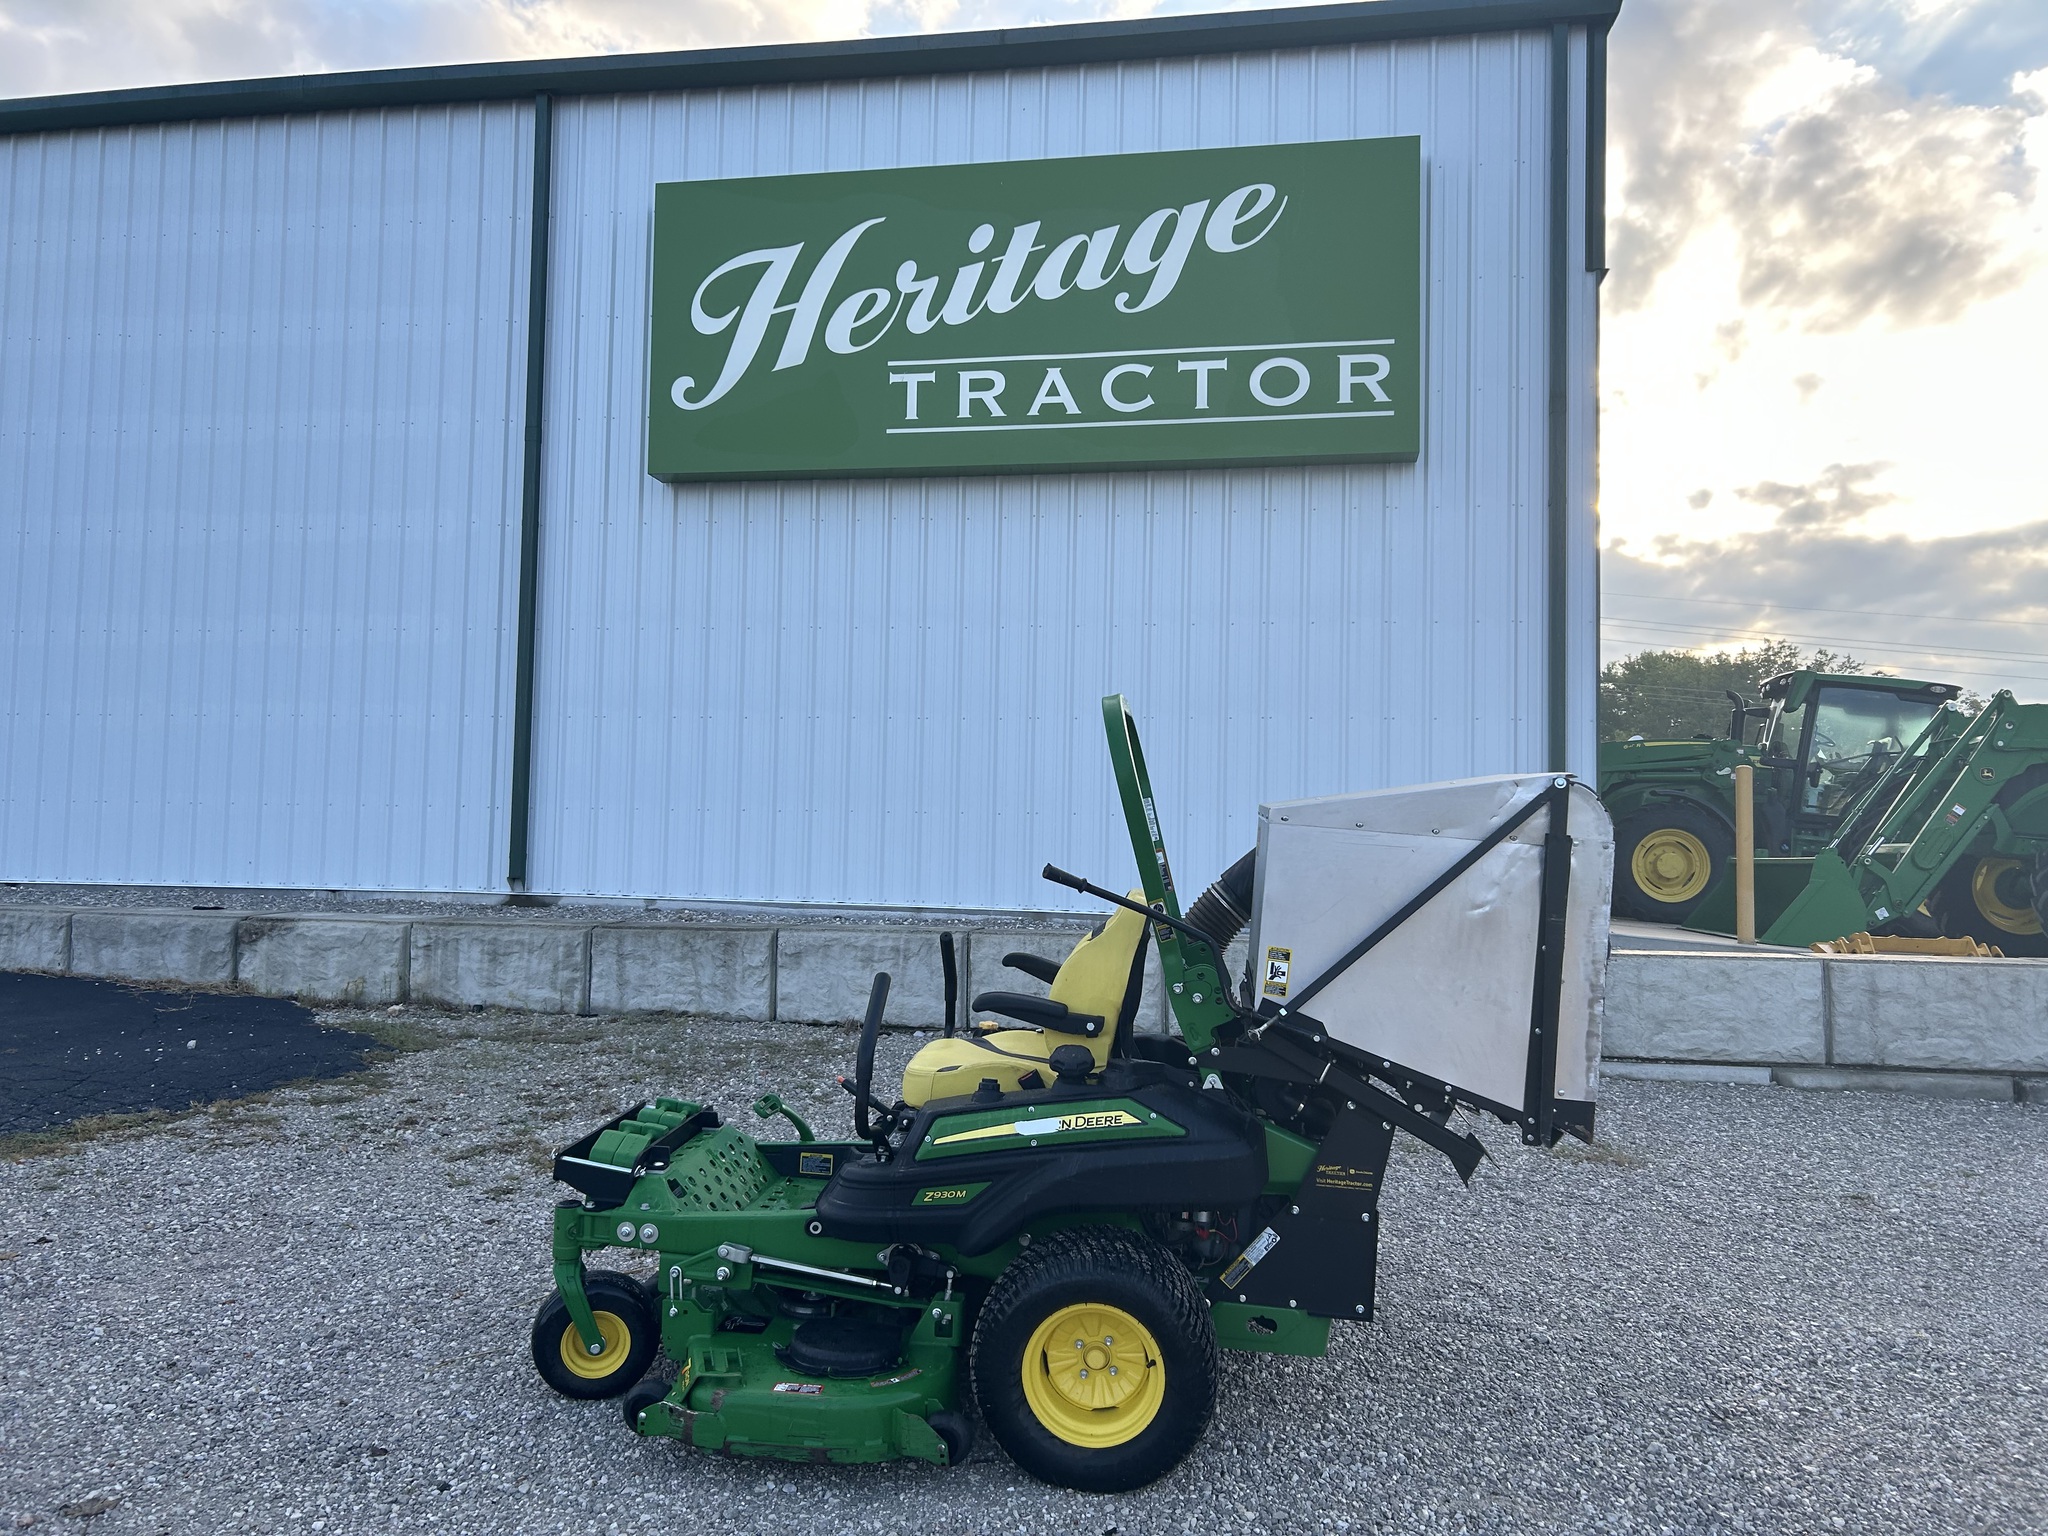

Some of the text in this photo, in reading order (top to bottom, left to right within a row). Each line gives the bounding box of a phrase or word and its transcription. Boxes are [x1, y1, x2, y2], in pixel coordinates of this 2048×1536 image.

[670, 183, 1288, 410] Heritage
[889, 354, 1392, 420] TRACTOR
[1075, 1115, 1123, 1128] DEERE
[923, 1190, 967, 1202] Z930M
